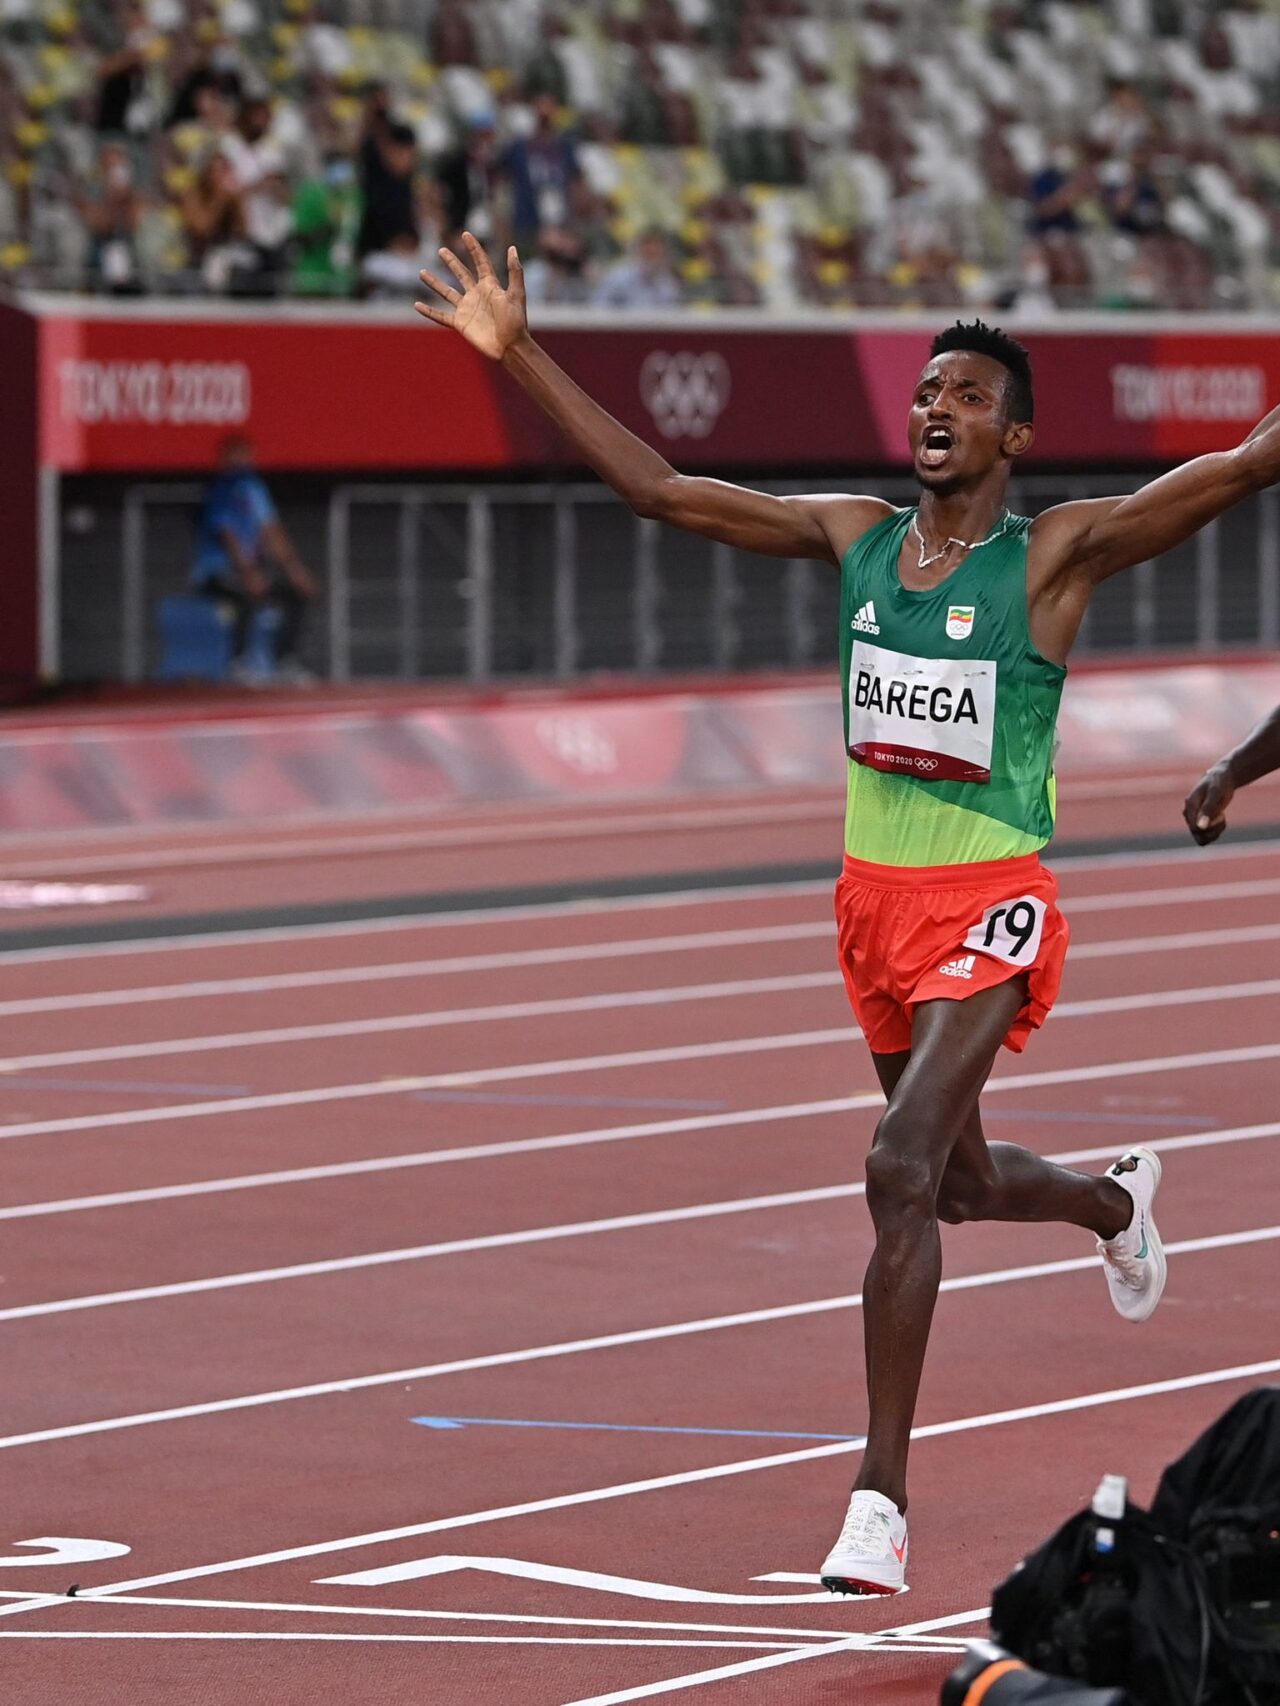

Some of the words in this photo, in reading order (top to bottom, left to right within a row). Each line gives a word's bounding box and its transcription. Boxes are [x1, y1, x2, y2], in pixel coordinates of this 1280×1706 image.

[851, 619, 880, 636] adidas
[855, 670, 979, 725] BAREGA
[874, 751, 895, 762] TOKYO
[896, 755, 913, 766] 2020
